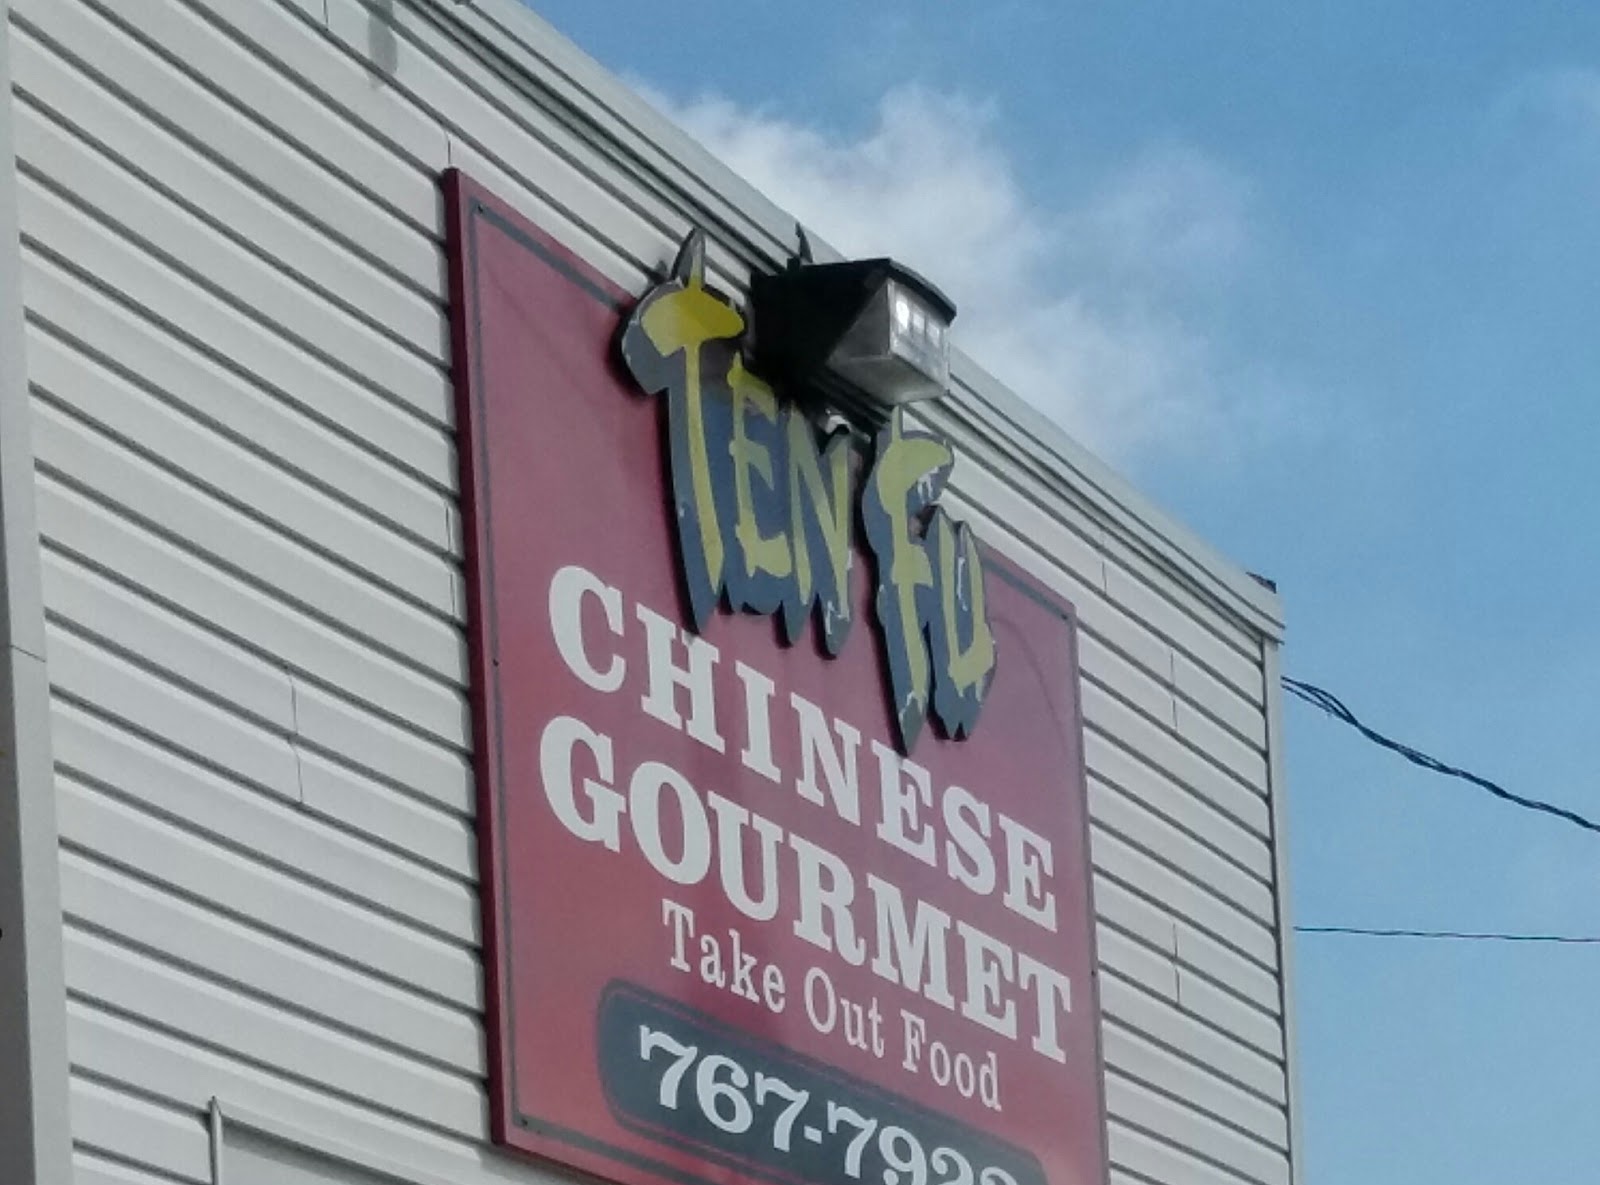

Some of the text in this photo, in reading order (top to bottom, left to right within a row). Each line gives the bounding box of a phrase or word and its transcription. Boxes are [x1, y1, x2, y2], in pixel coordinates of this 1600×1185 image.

[540, 715, 1071, 1065] GOURMET
[548, 565, 1057, 933] CHINESE
[662, 898, 1003, 1112] Take Out Food
